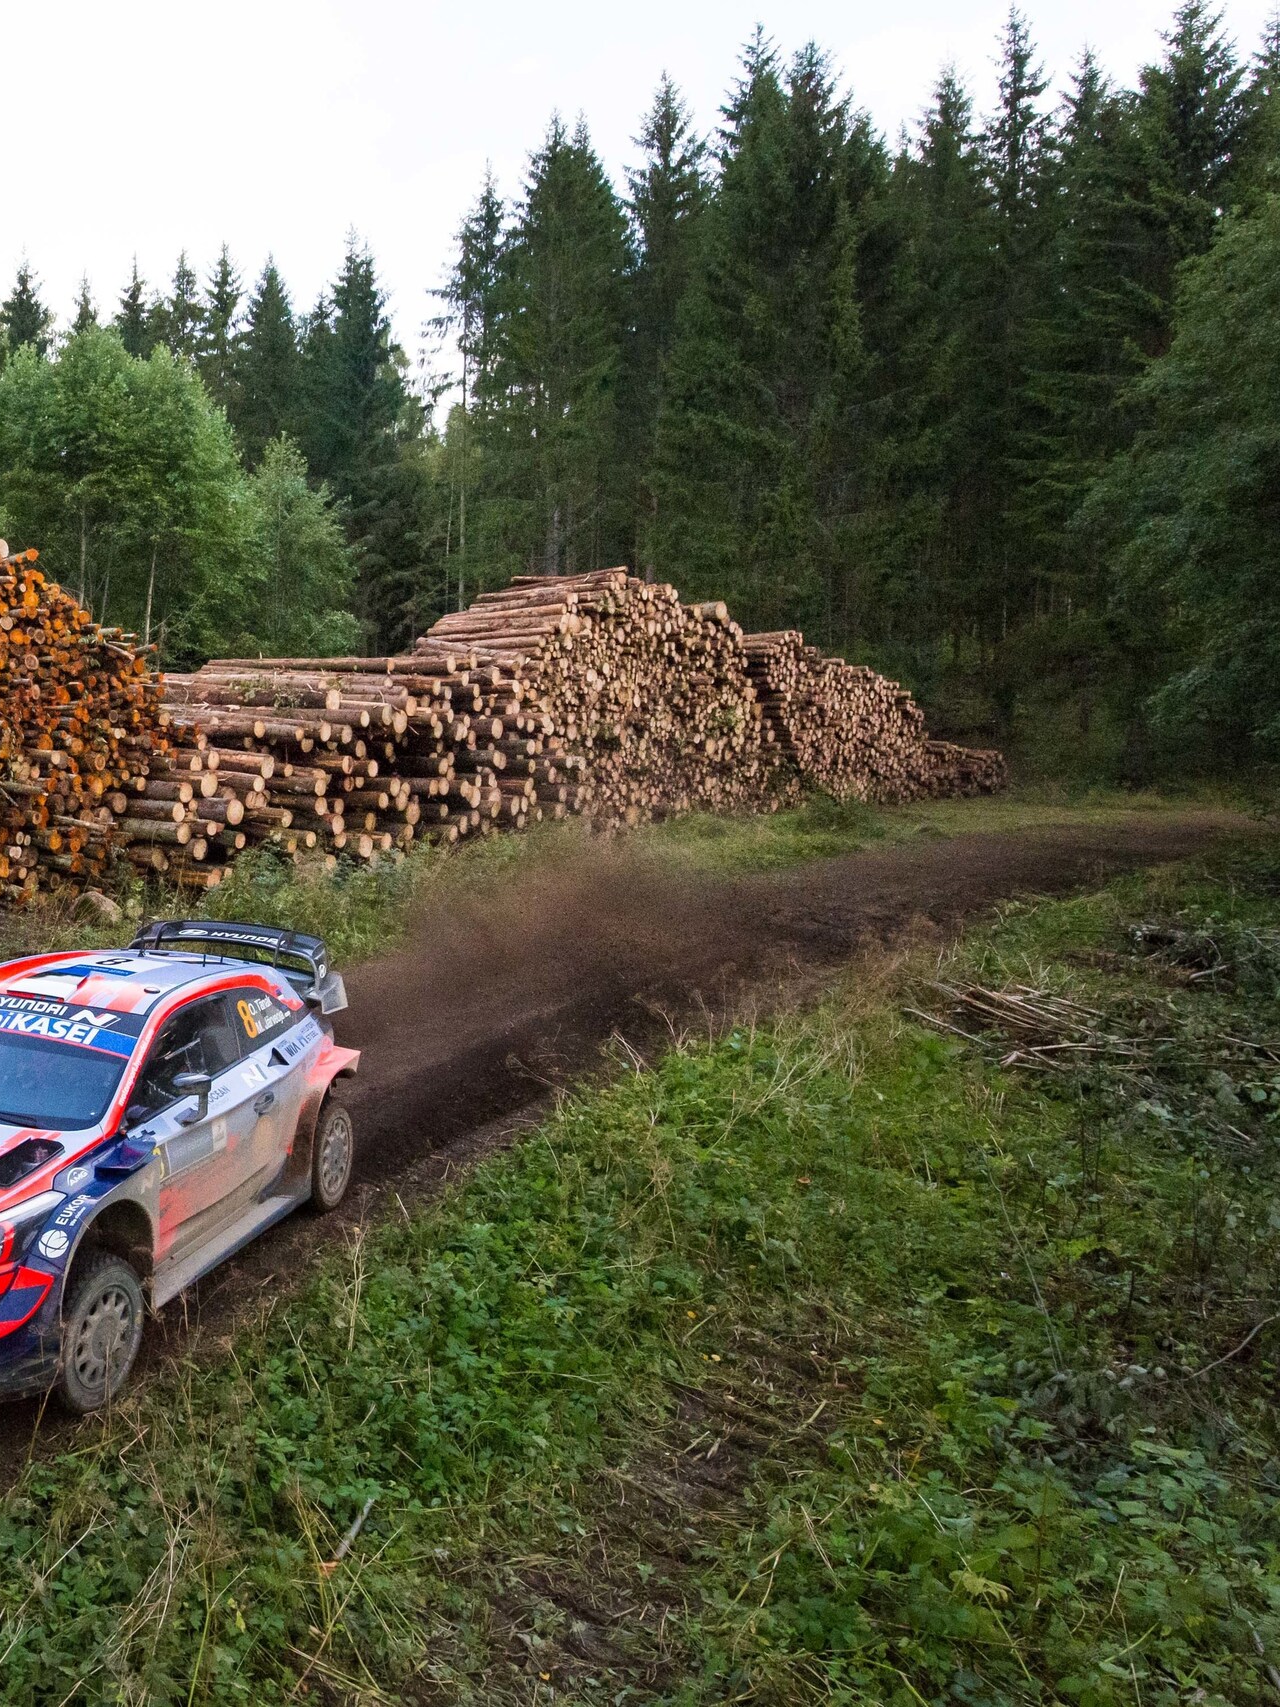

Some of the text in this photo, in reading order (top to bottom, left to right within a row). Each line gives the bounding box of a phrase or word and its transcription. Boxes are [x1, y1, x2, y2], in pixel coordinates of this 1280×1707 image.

[210, 931, 286, 946] HYUNDAI
[95, 957, 134, 966] 8
[236, 1000, 258, 1039] 8
[55, 1194, 92, 1226] EUKOR
